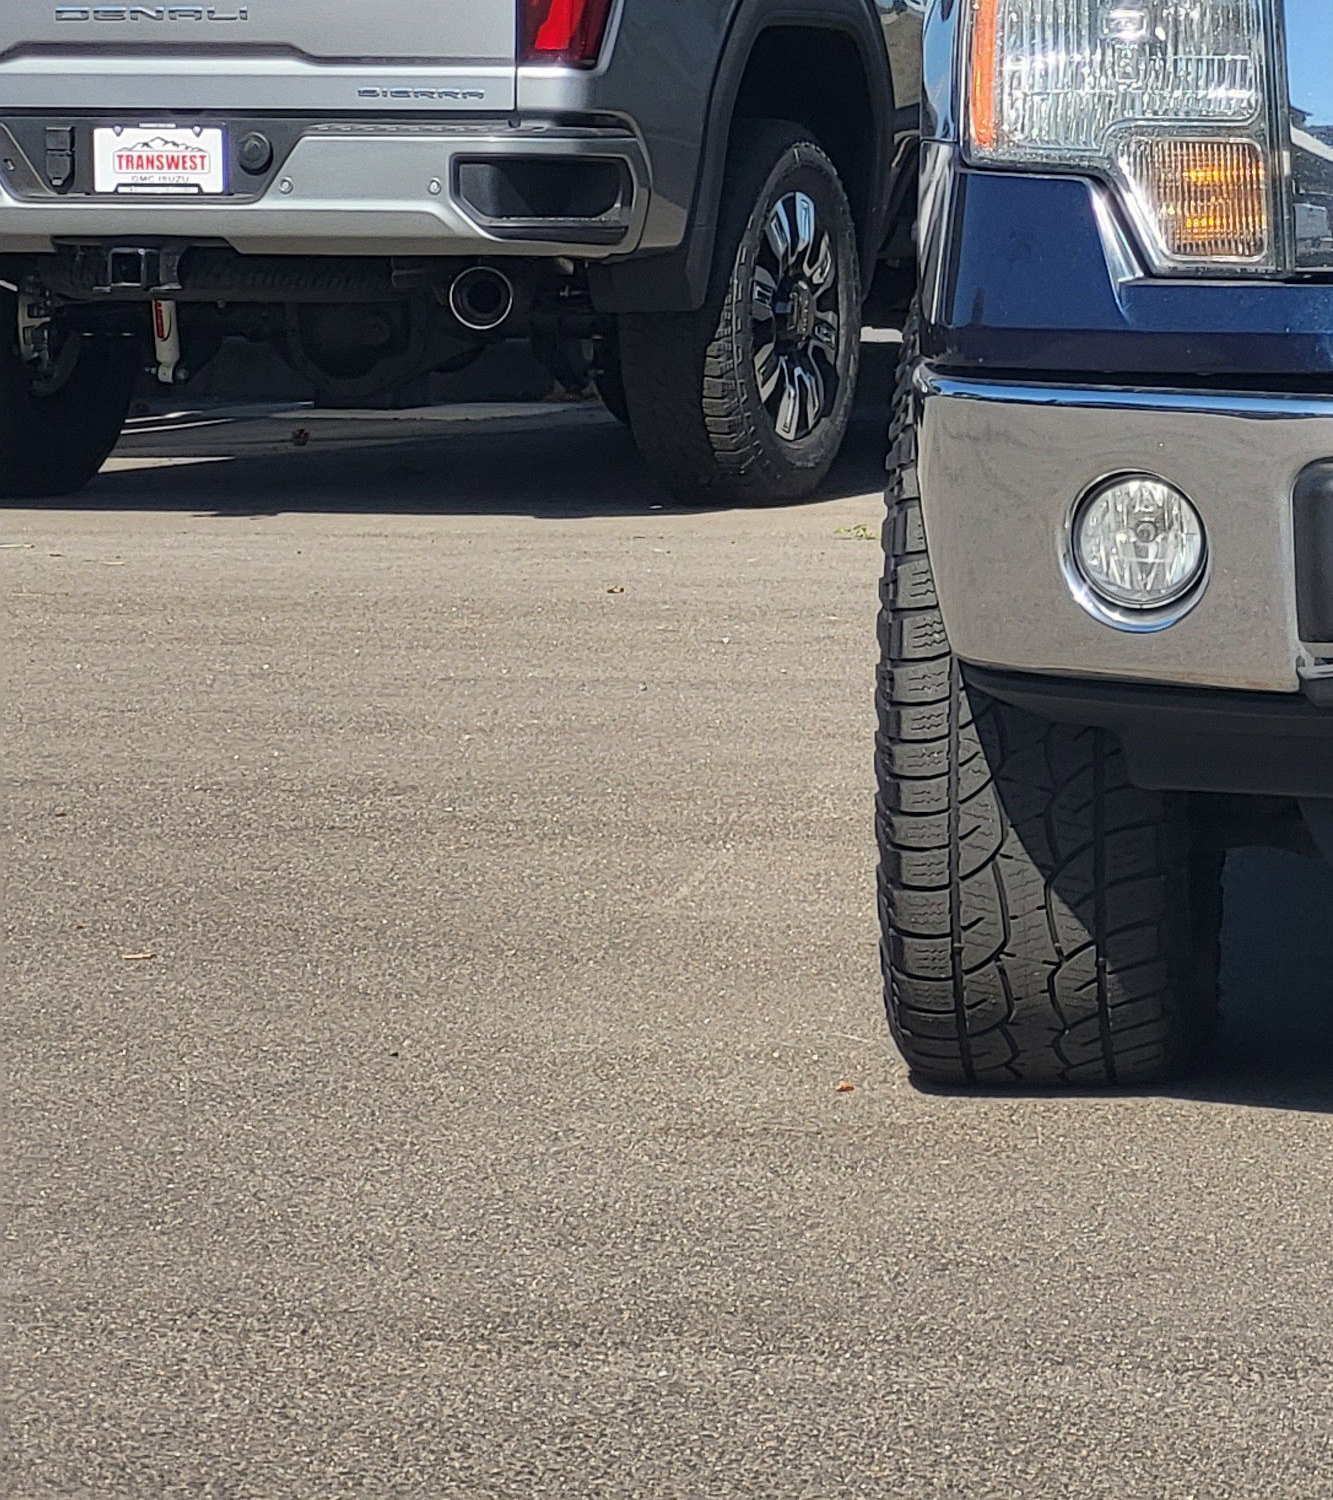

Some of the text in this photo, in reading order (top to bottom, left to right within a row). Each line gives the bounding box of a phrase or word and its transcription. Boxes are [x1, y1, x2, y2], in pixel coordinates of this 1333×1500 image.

[55, 5, 248, 21] DENALI
[357, 86, 485, 100] SIERRA
[116, 154, 207, 171] TRANSWEST
